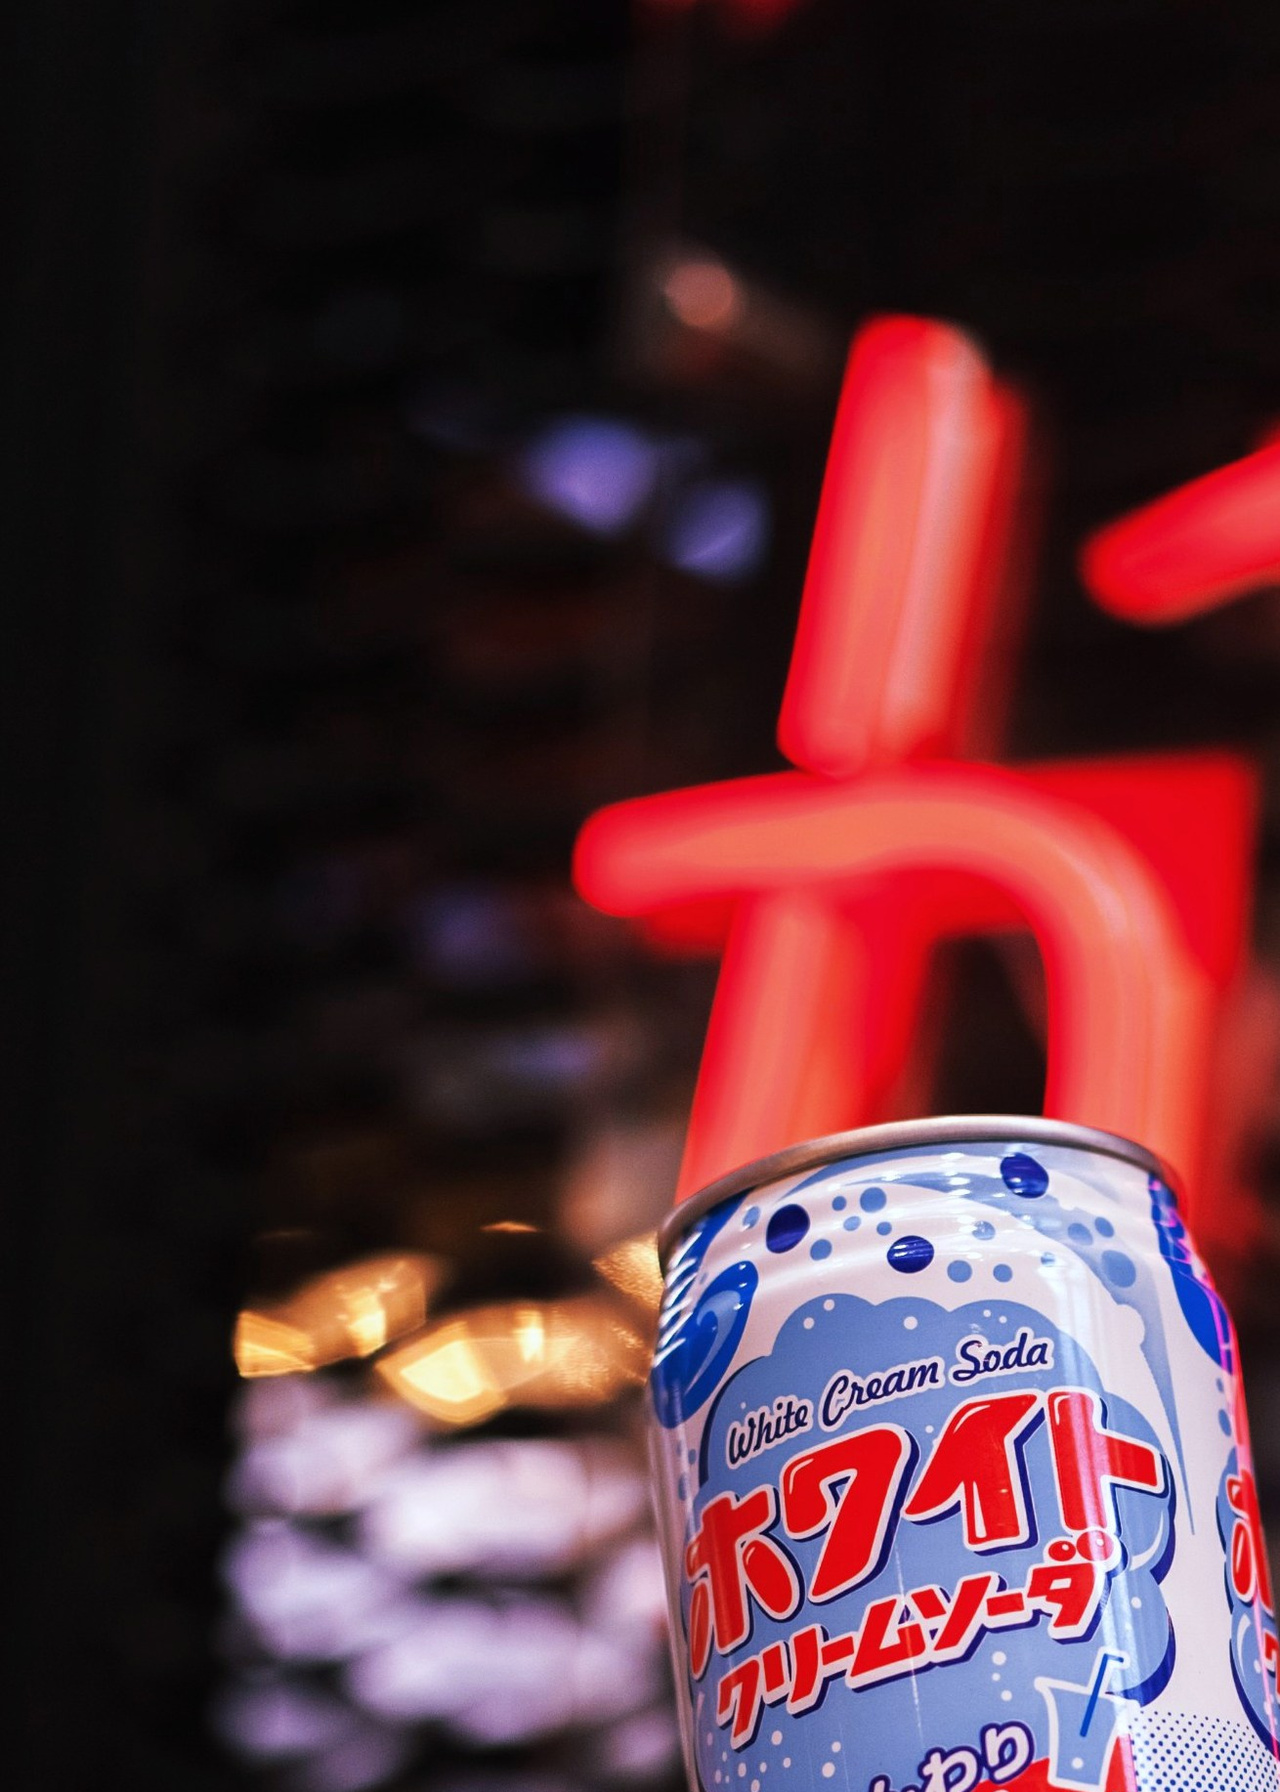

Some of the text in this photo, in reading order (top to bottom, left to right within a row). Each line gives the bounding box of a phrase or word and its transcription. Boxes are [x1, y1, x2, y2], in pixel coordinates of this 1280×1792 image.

[728, 1332, 1050, 1463] White Cream Soda
[684, 1389, 1163, 1682] ホワイト
[717, 1537, 1117, 1742] クリームソーダ
